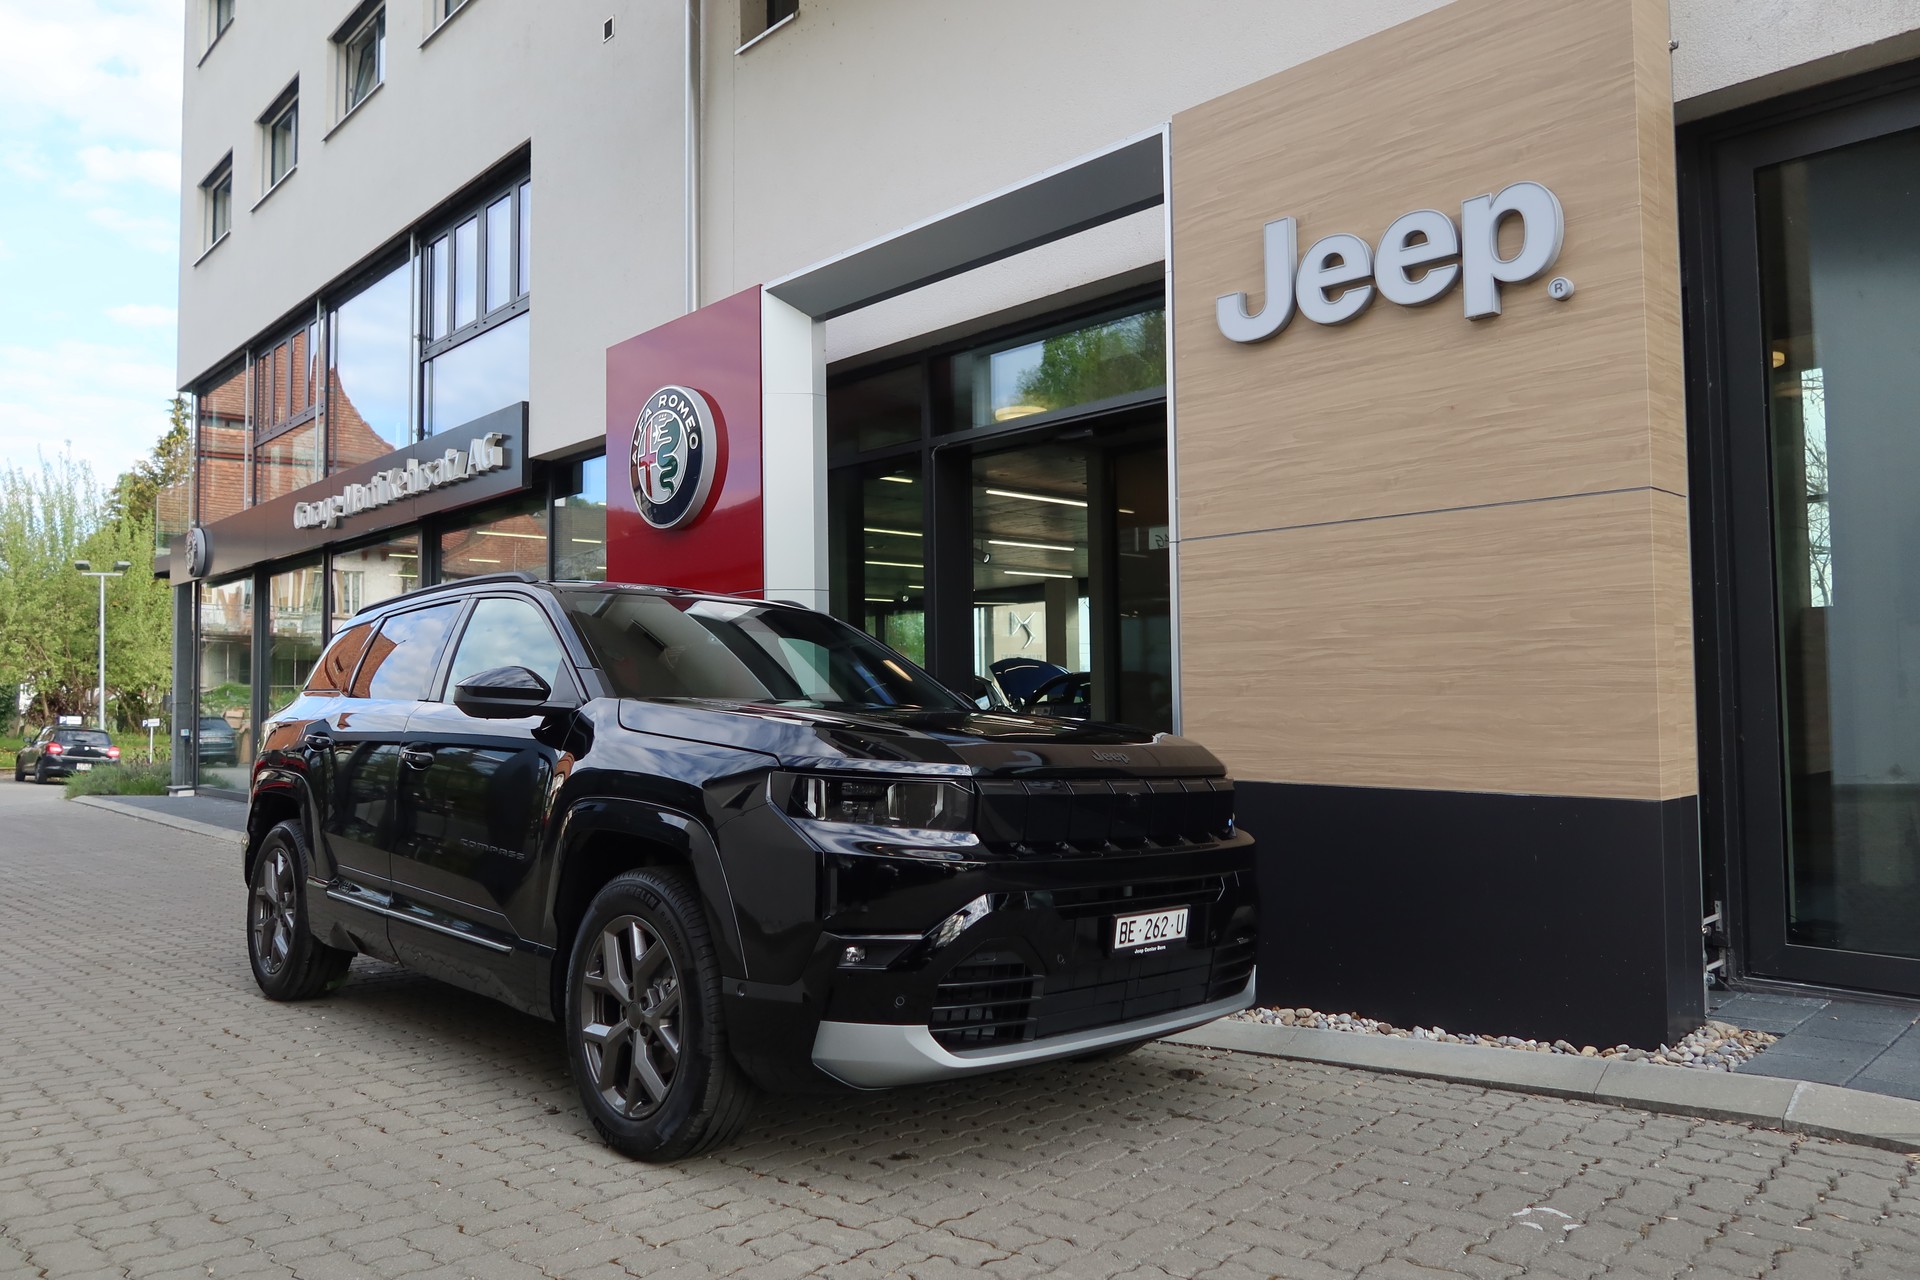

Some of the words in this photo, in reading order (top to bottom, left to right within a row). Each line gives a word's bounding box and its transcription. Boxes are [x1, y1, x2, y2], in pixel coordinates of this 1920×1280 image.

[1215, 180, 1565, 344] Jeep
[631, 407, 653, 464] ALFA
[657, 394, 699, 450] ROMEO
[466, 431, 503, 475] AG
[1091, 749, 1130, 766] Jeep
[460, 838, 525, 860] COMPASS
